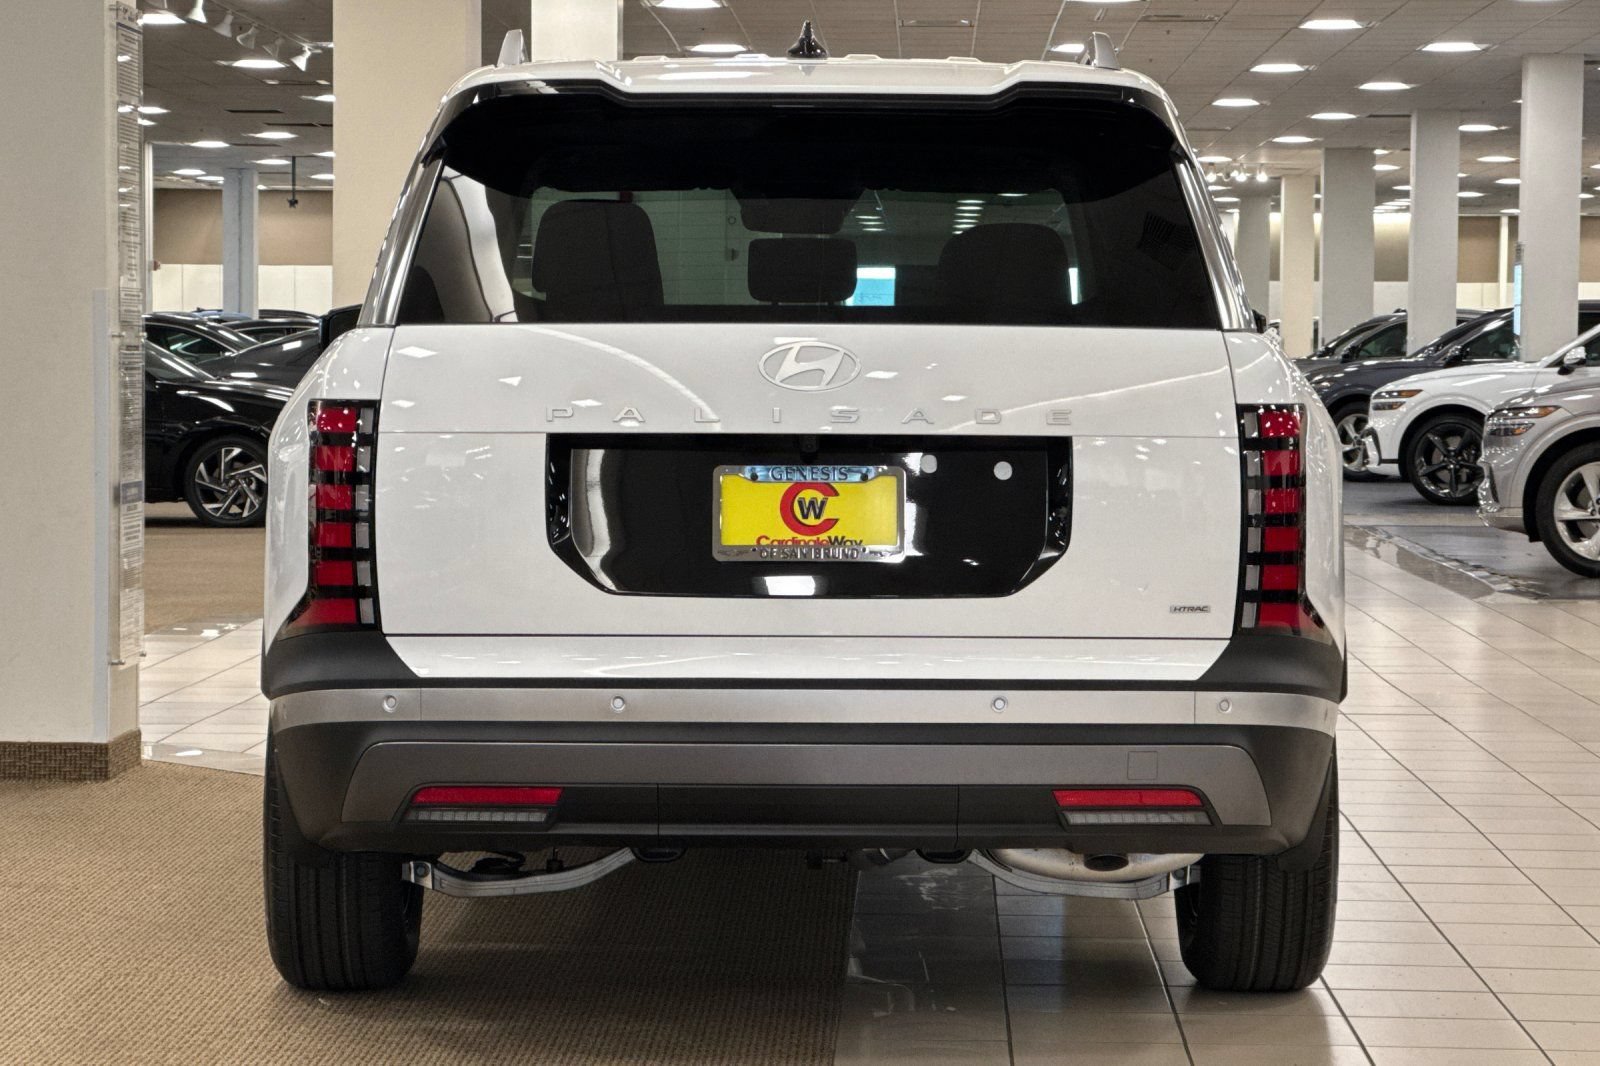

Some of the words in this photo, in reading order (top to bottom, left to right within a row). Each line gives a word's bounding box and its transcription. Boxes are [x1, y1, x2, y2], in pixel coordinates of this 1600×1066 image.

[545, 406, 1073, 425] PALISADE
[770, 466, 849, 481] GENESIS
[760, 547, 777, 559] OF
[781, 547, 808, 559] SAN
[812, 547, 860, 559] BRUNO
